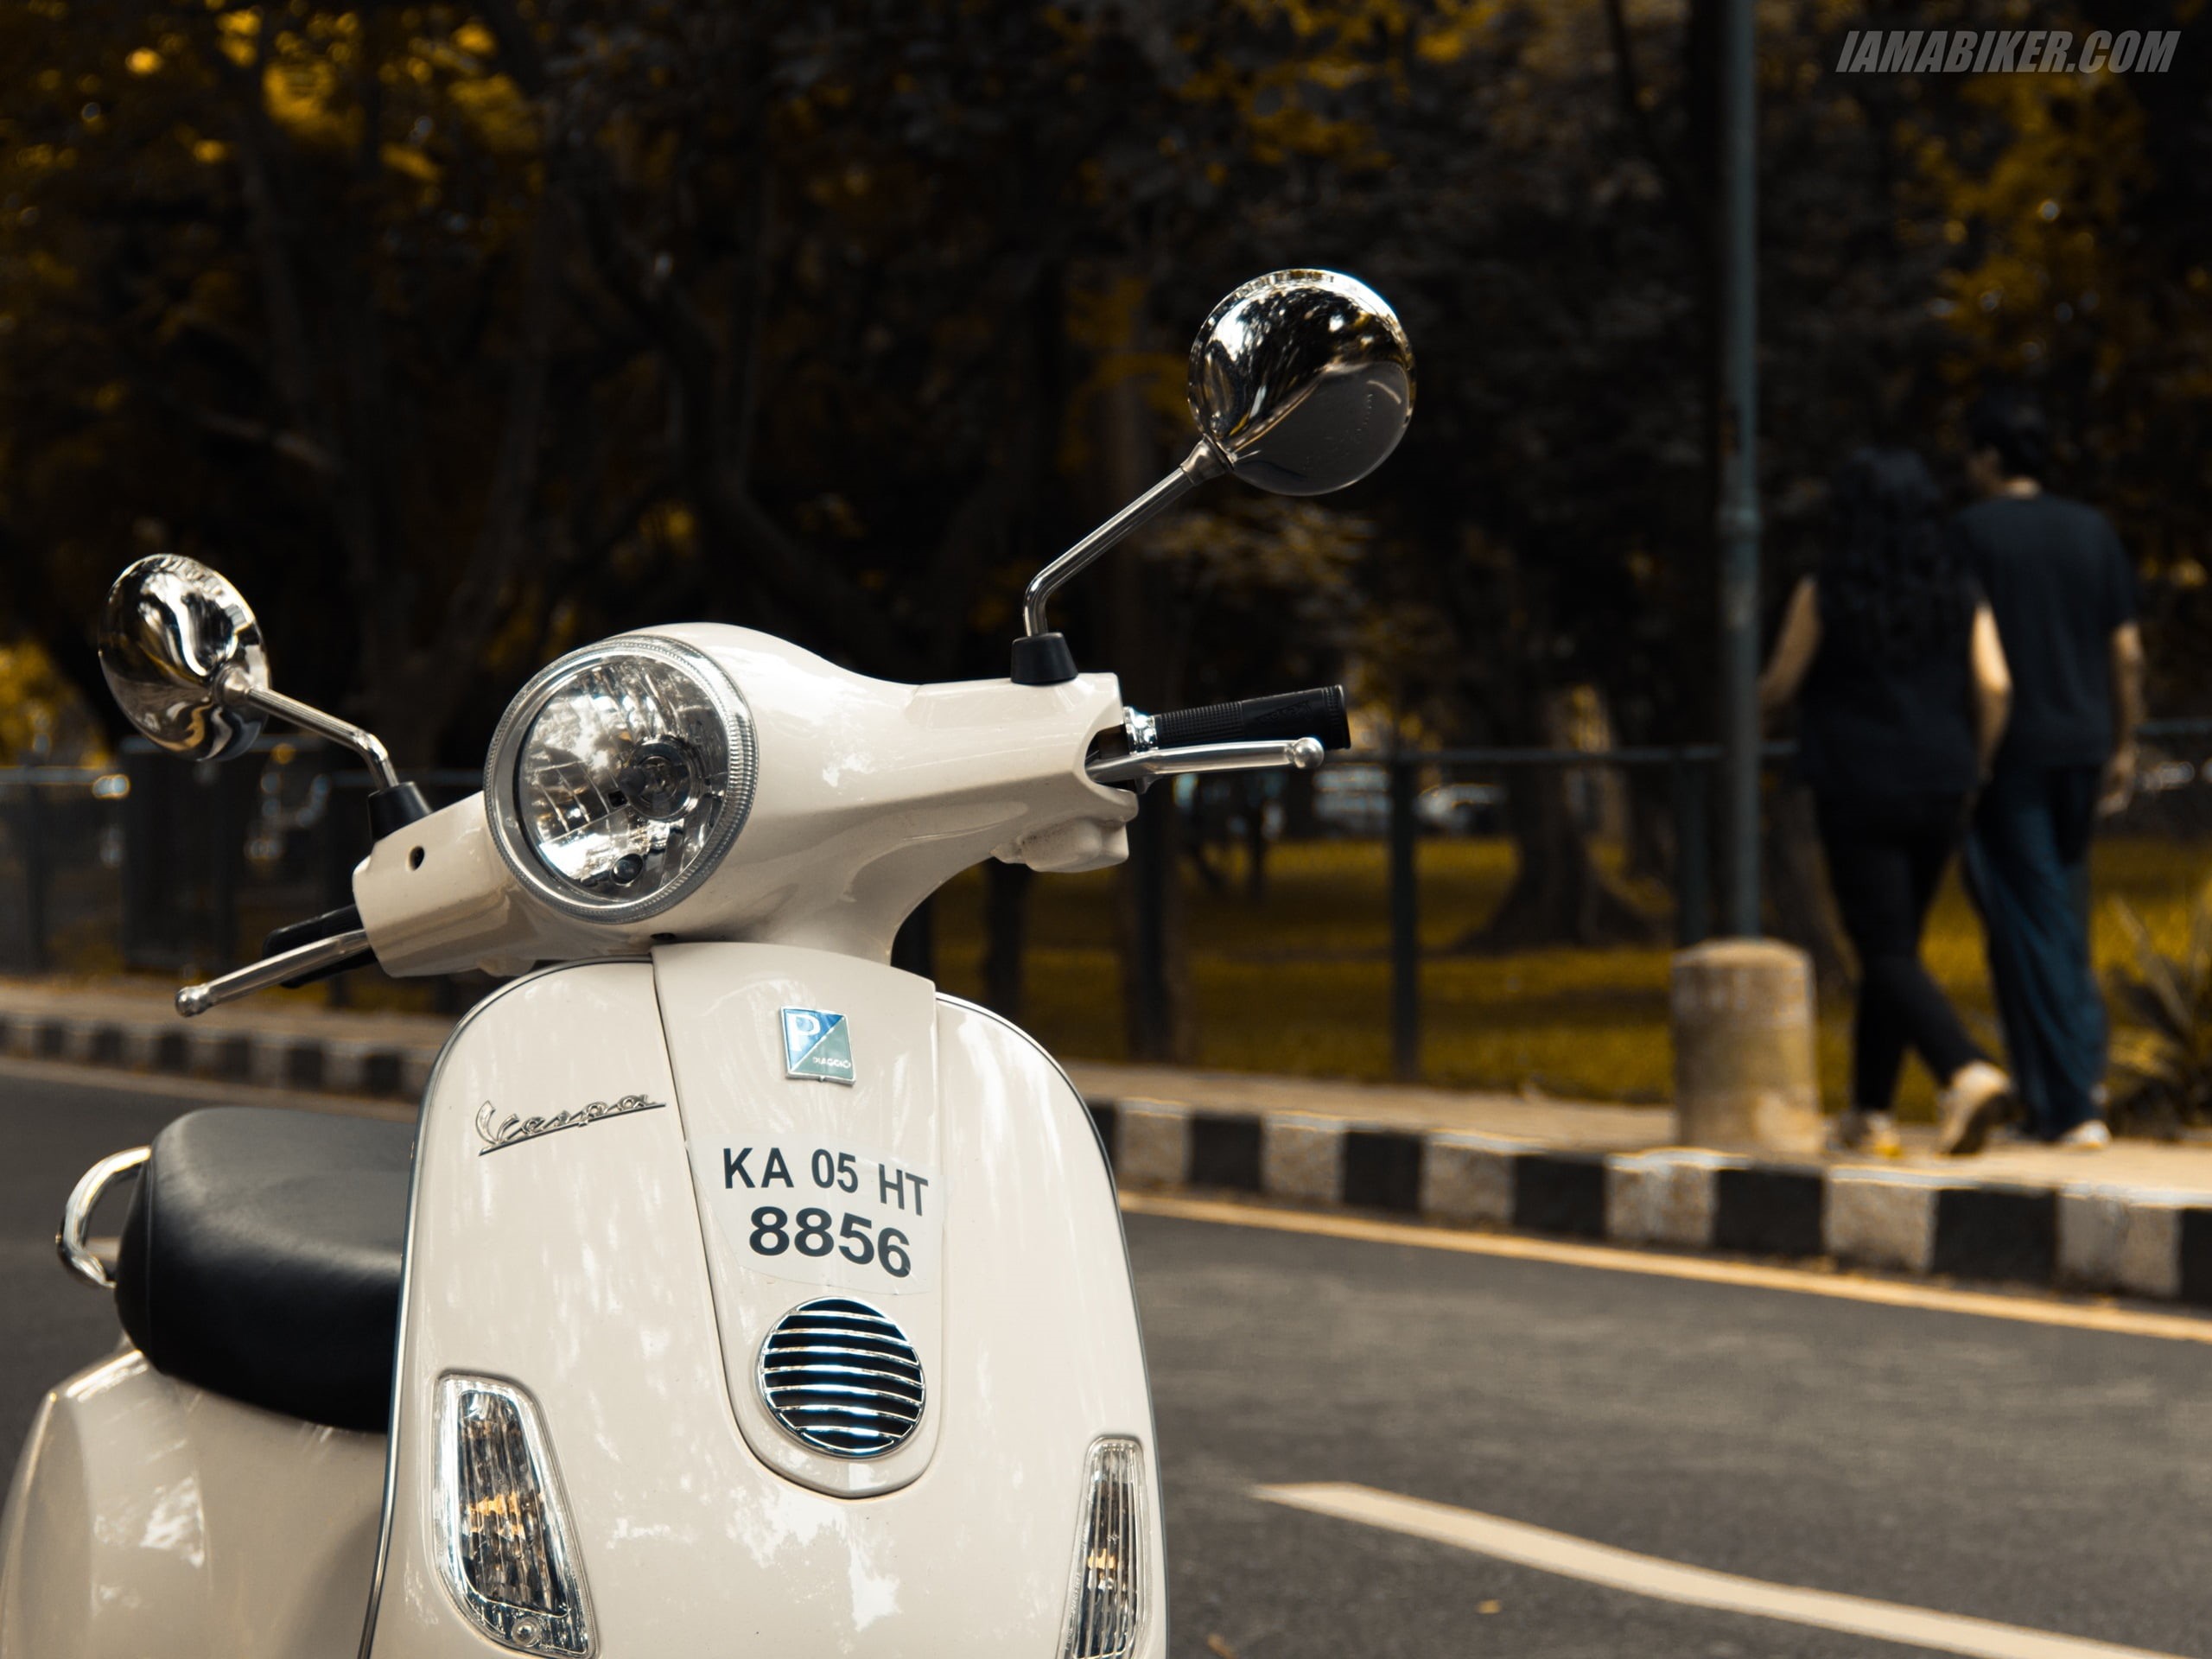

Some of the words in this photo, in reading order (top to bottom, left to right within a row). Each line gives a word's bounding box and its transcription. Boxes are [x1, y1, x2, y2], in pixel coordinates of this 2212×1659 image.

[475, 1094, 666, 1157] Vespa
[722, 1147, 795, 1190] KA
[810, 1148, 859, 1194] 05
[878, 1163, 930, 1217] HT
[748, 1205, 912, 1279] 8856
